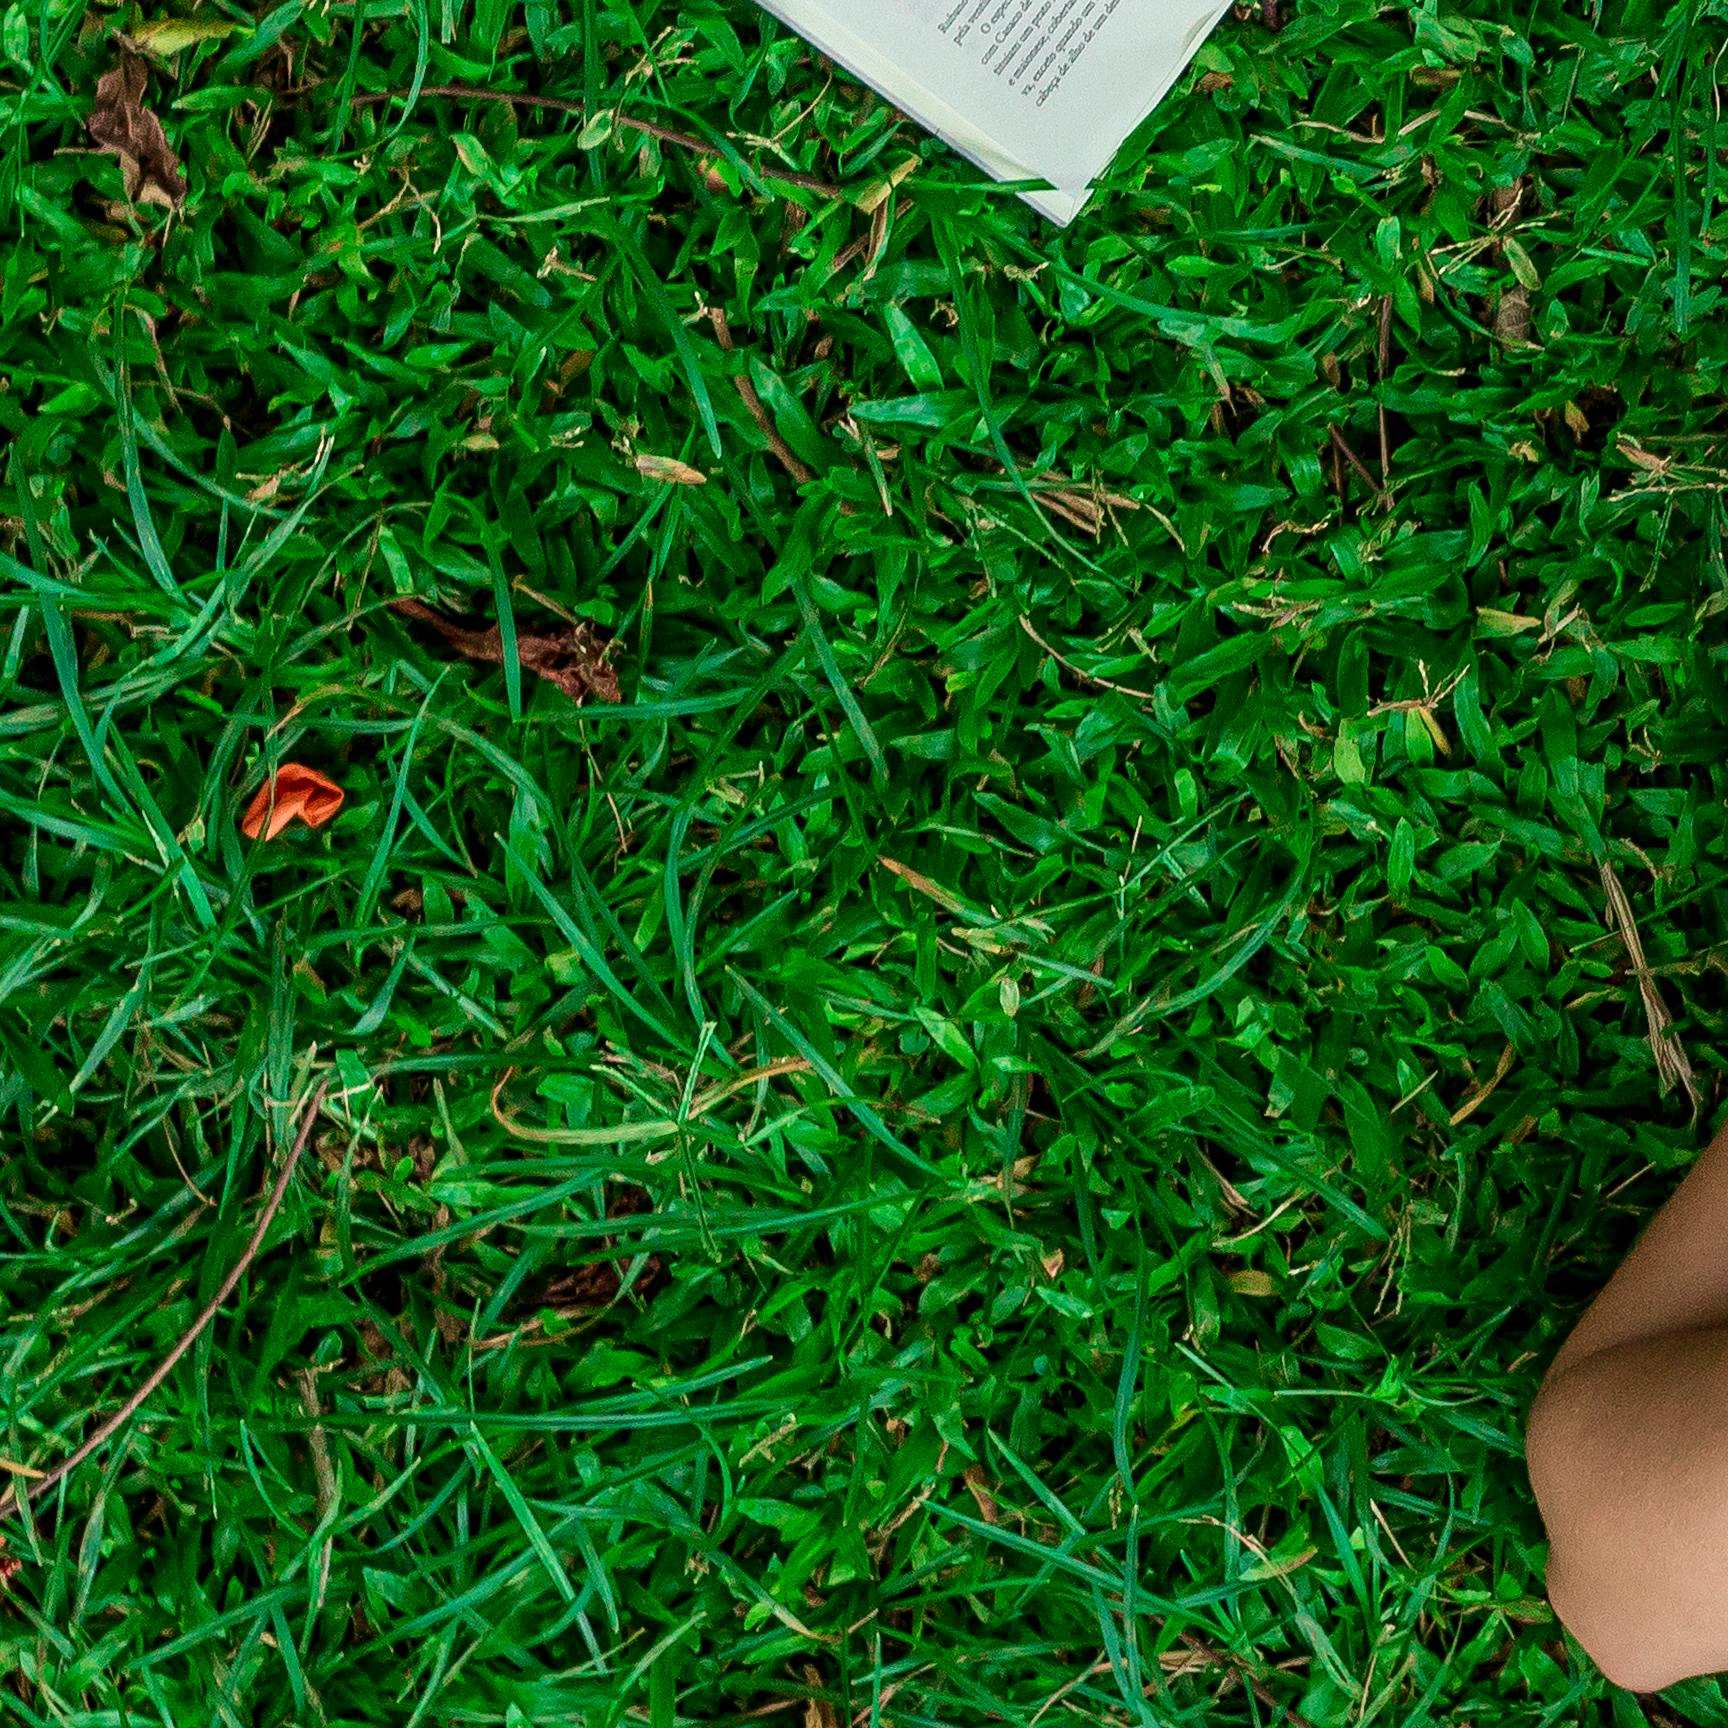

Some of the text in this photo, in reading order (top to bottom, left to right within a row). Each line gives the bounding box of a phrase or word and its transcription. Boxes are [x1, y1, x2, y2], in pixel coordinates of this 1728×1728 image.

[1035, 74, 1062, 108] cabeça
[1056, 62, 1071, 77] de
[1081, 29, 1097, 44] de
[1091, 12, 1109, 32] um
